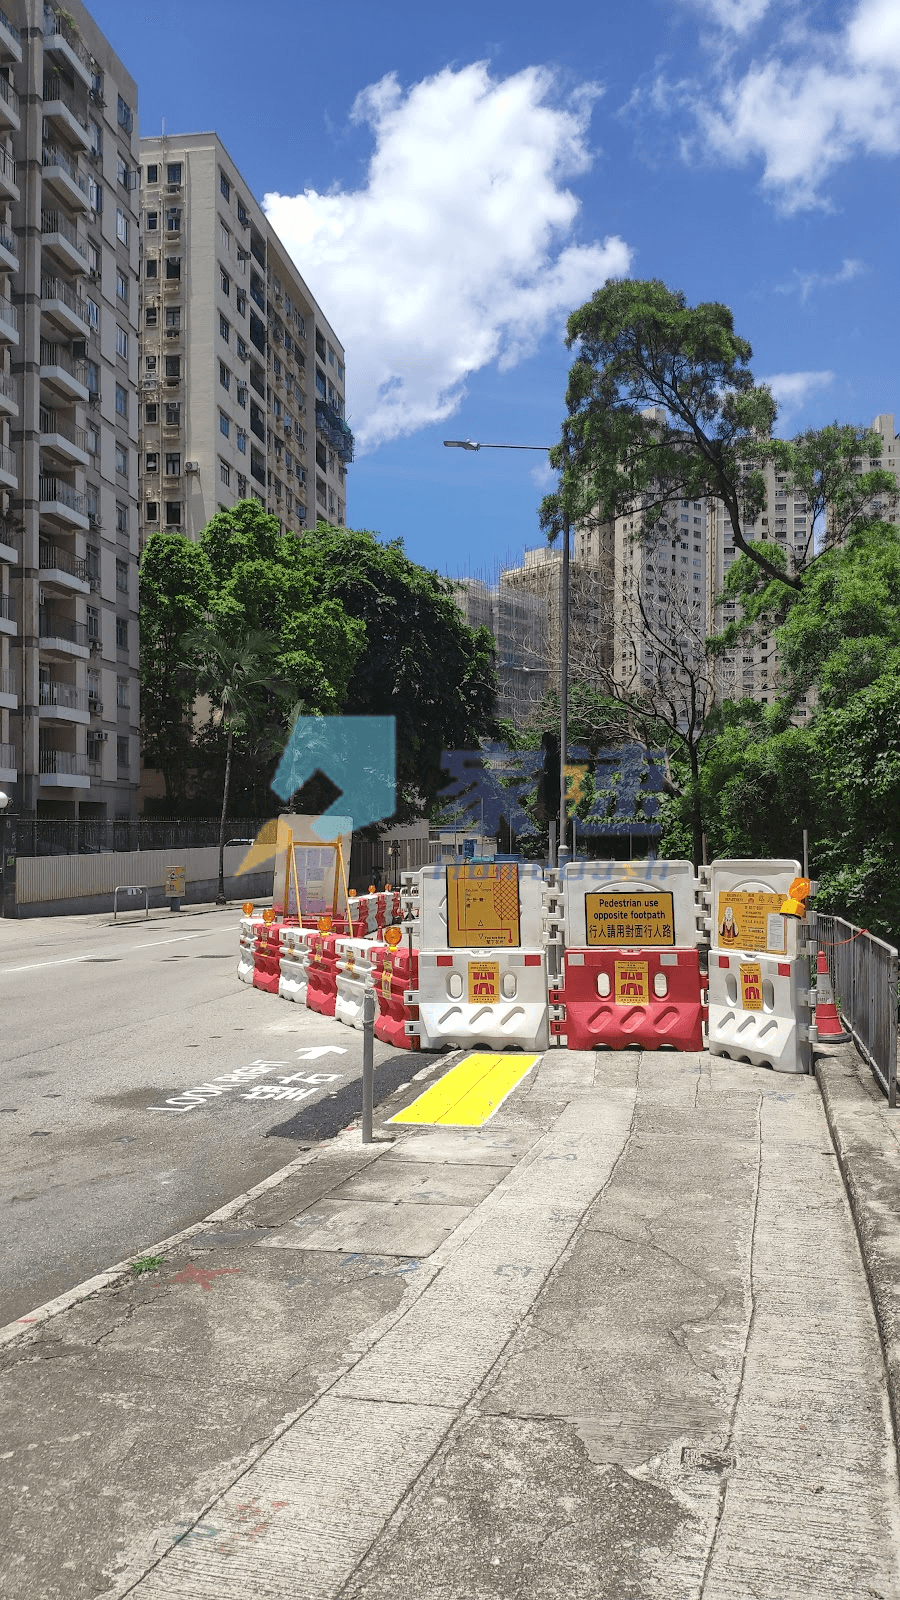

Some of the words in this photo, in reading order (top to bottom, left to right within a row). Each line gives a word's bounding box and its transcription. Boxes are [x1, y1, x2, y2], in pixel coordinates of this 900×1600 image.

[599, 899, 641, 907] Pedestrian
[593, 911, 628, 921] opposite
[630, 910, 666, 920] footpath
[589, 924, 672, 938] 行人請用對面行人路
[146, 1083, 240, 1112] LOOK
[213, 1060, 289, 1082] RIGHT
